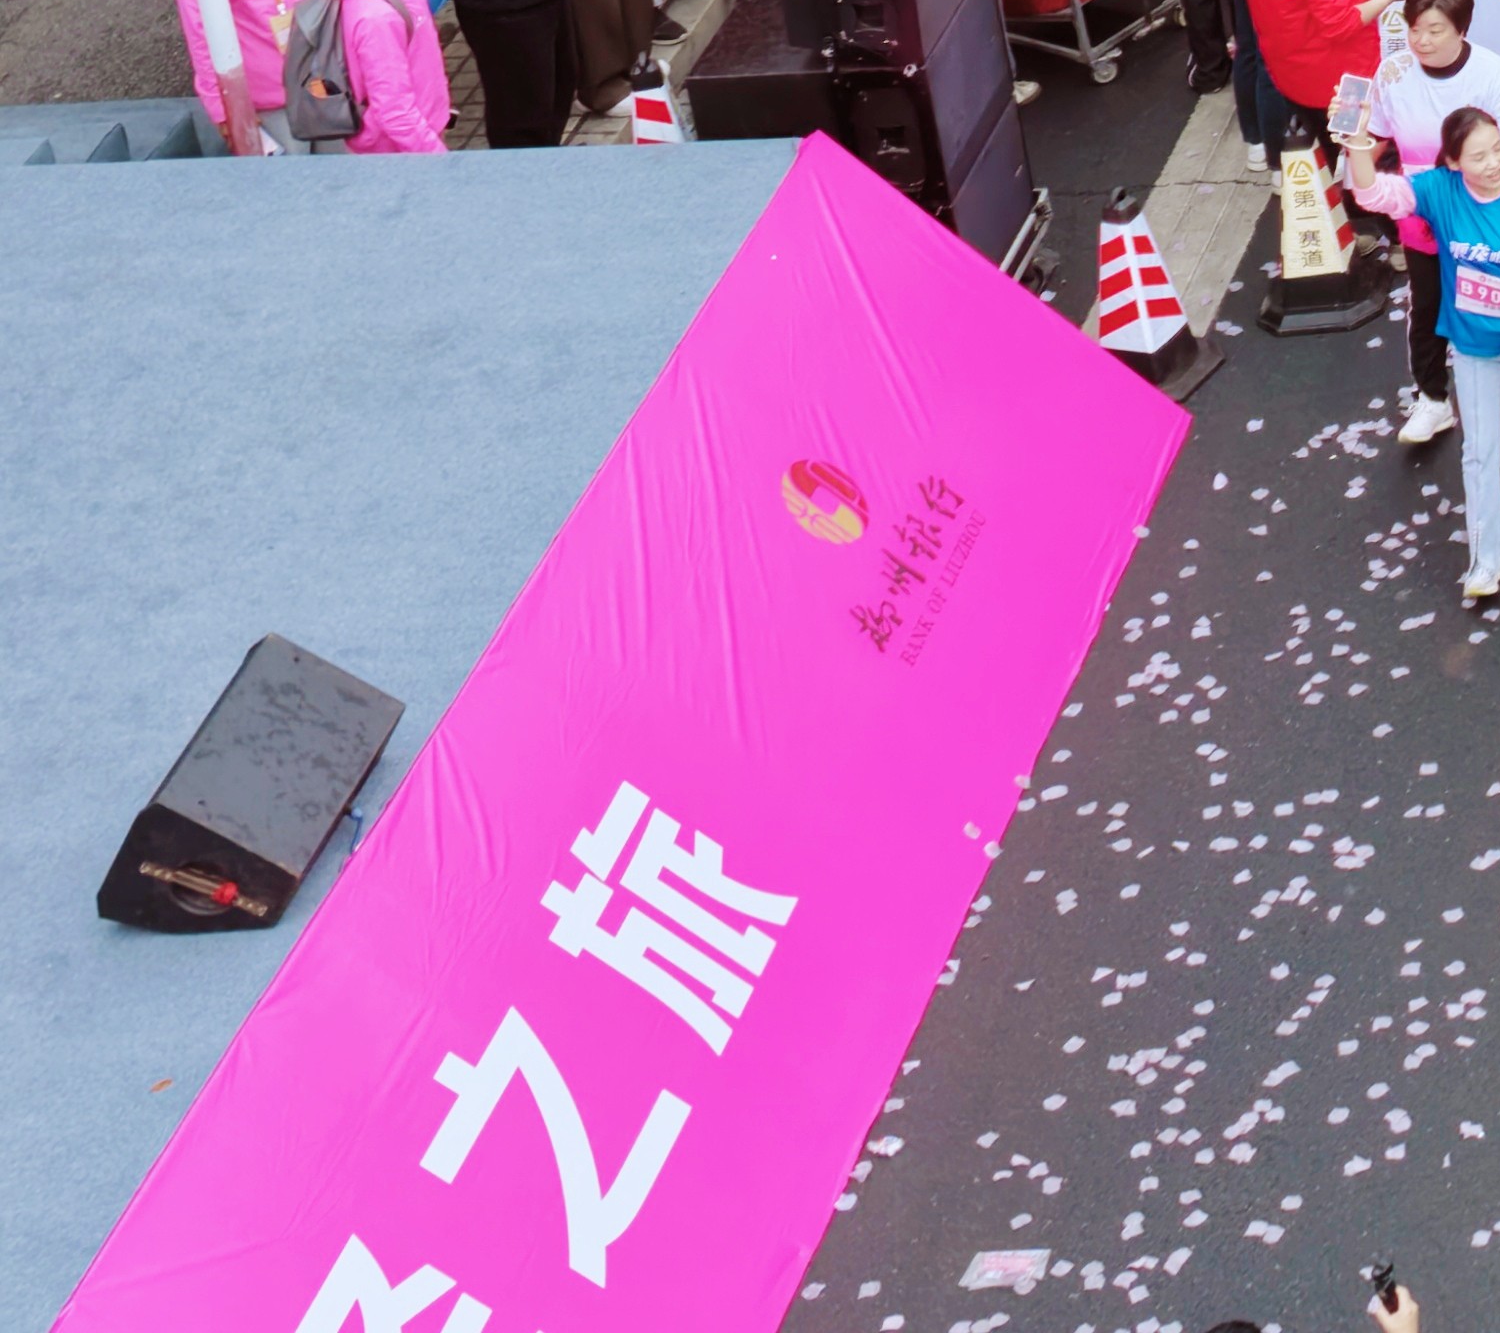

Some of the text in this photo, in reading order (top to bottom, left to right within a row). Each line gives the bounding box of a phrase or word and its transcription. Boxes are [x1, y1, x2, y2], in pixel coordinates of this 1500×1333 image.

[1294, 189, 1325, 269] 第一赛道
[853, 474, 965, 654] 柳州银行
[901, 616, 934, 669] BANK
[939, 510, 988, 591] LIUZHOU
